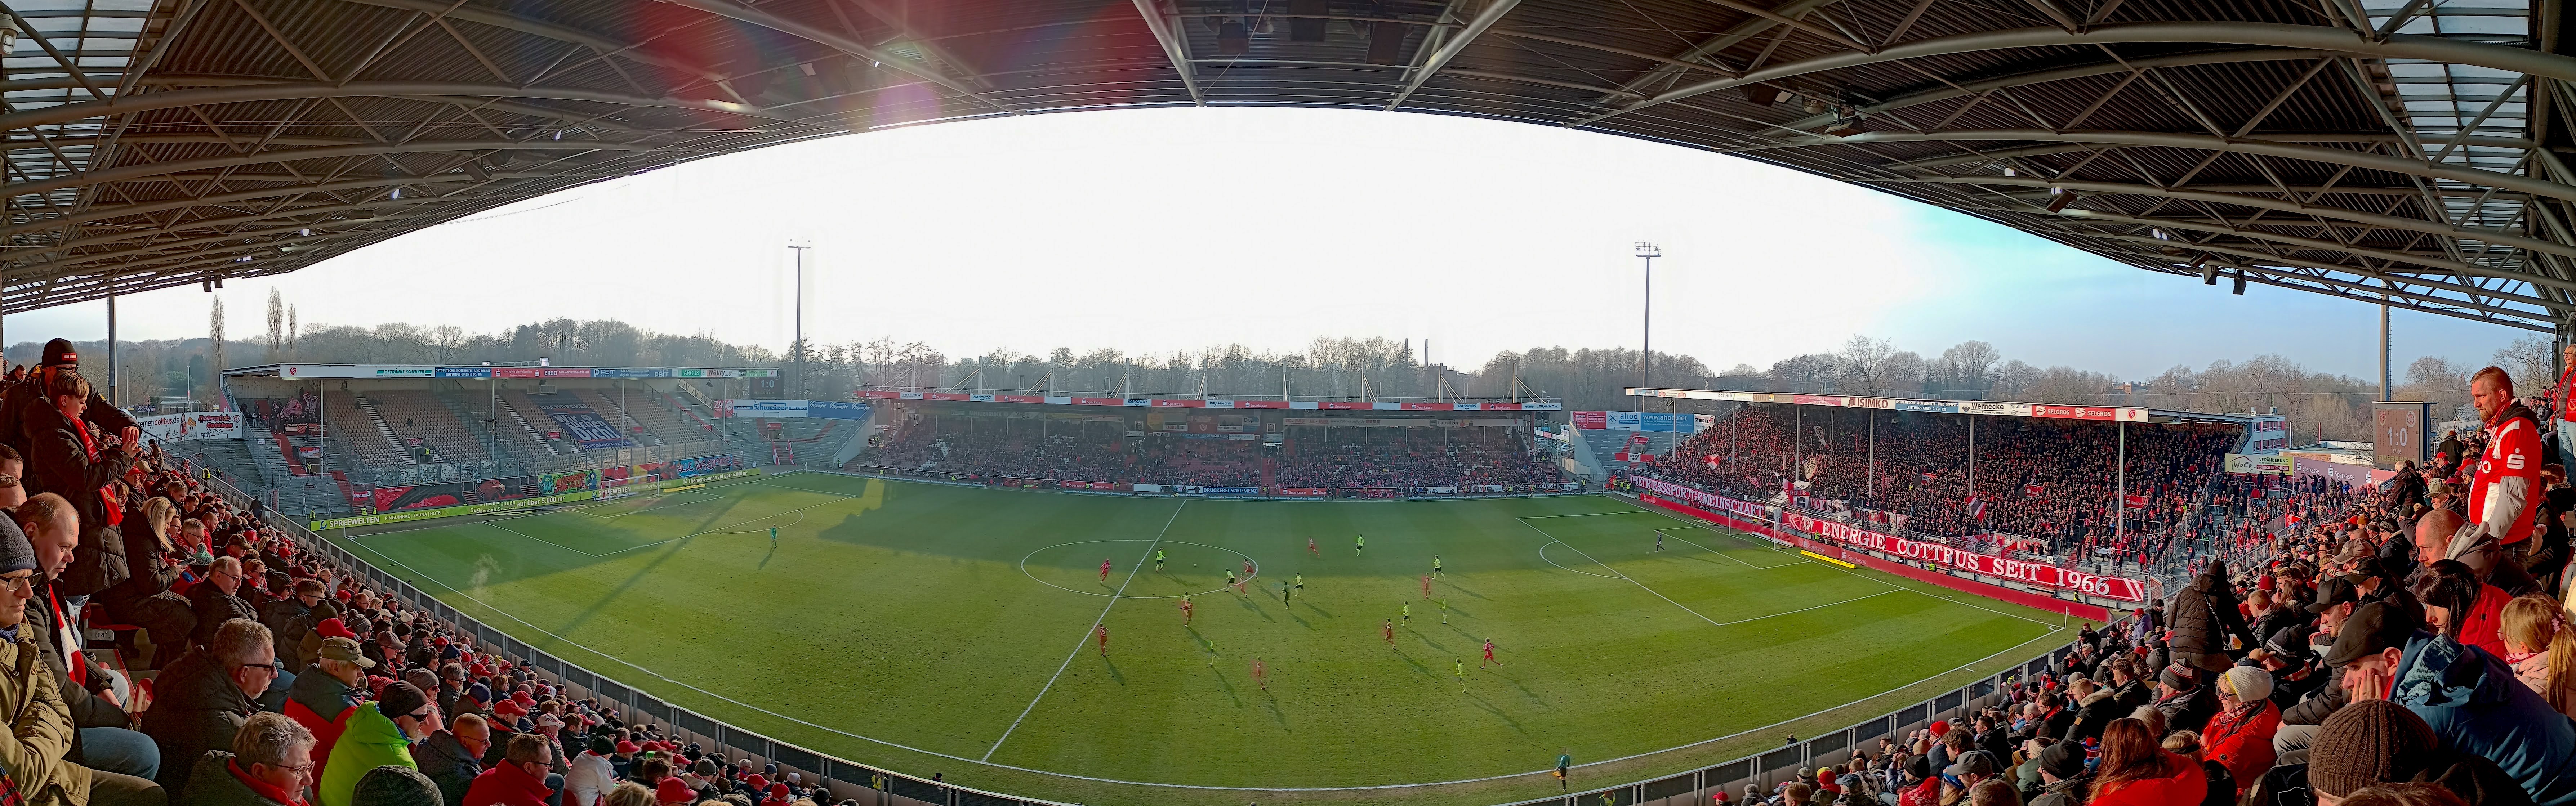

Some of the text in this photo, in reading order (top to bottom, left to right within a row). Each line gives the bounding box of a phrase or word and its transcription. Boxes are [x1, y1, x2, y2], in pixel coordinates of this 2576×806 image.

[753, 402, 788, 410] Schweizer
[1858, 398, 1888, 408] ISIMKO
[552, 415, 578, 423] Wir
[571, 426, 621, 441] Dich!
[2387, 427, 2407, 447] 1:0
[2302, 465, 2319, 474] Sparkasse
[2335, 471, 2355, 480] Sparkasse
[1634, 476, 1764, 518] BETRIEBSSPORTGEMEINSCHAFT
[329, 516, 380, 528] SPREEWELTEN
[1809, 544, 1826, 552] Sparkasse
[1822, 521, 1886, 550] ENERGIE
[1897, 539, 1979, 570] COTTBUS
[1993, 558, 2041, 581] SEIT
[2056, 568, 2110, 595] 1966
[1848, 555, 1867, 564] Sparkasse
